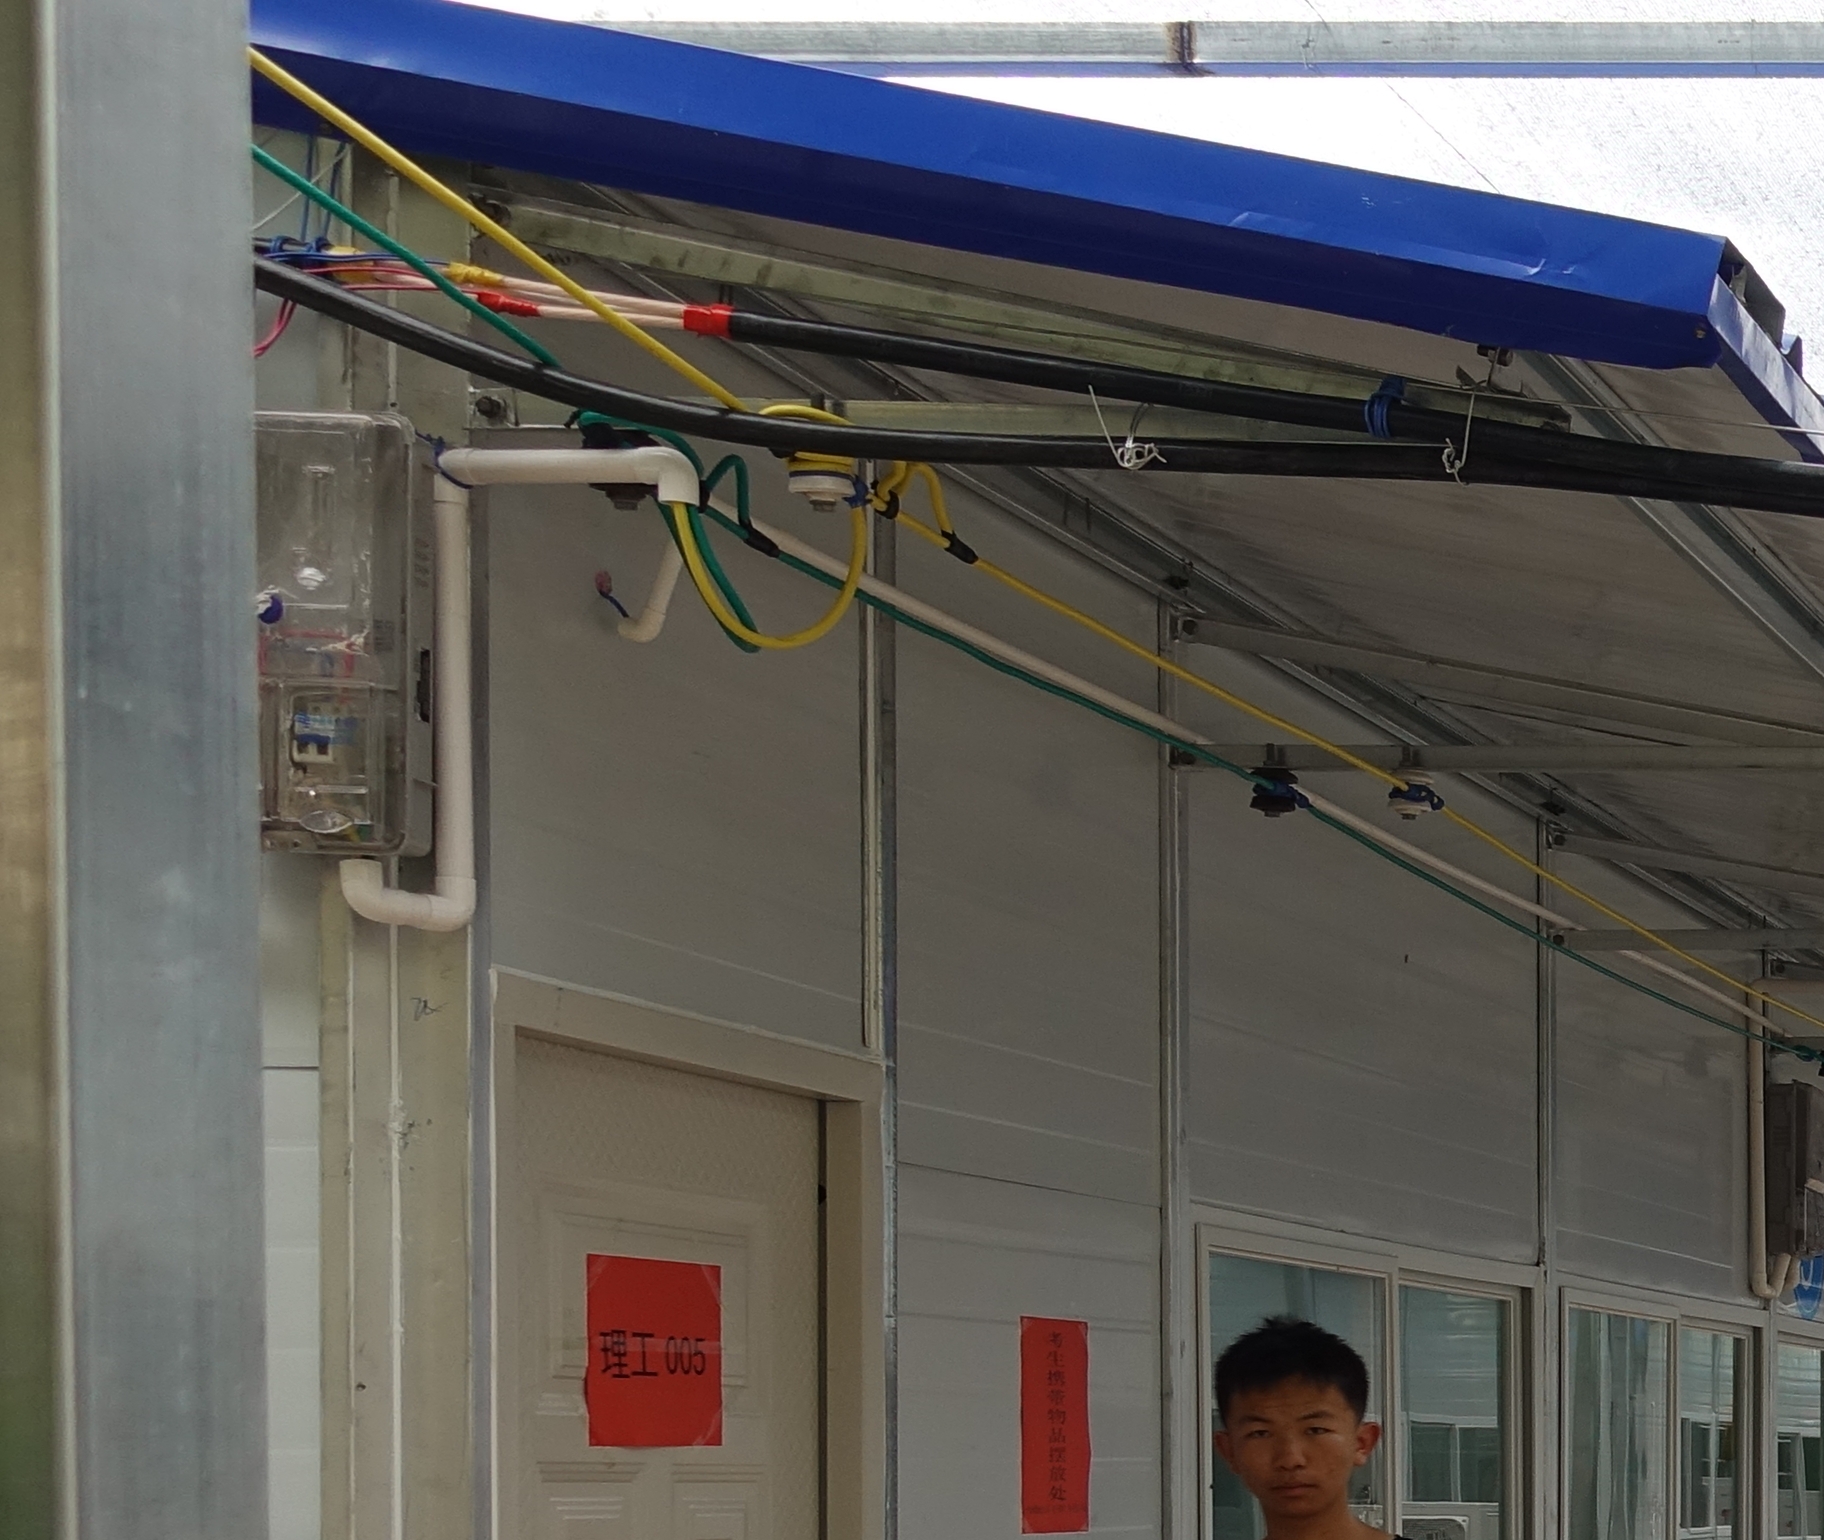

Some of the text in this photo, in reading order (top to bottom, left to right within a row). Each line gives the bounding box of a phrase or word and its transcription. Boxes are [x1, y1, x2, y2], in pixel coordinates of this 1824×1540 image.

[599, 1329, 707, 1379] 理工 005
[1046, 1331, 1067, 1501] 考生携带物品摆放处
